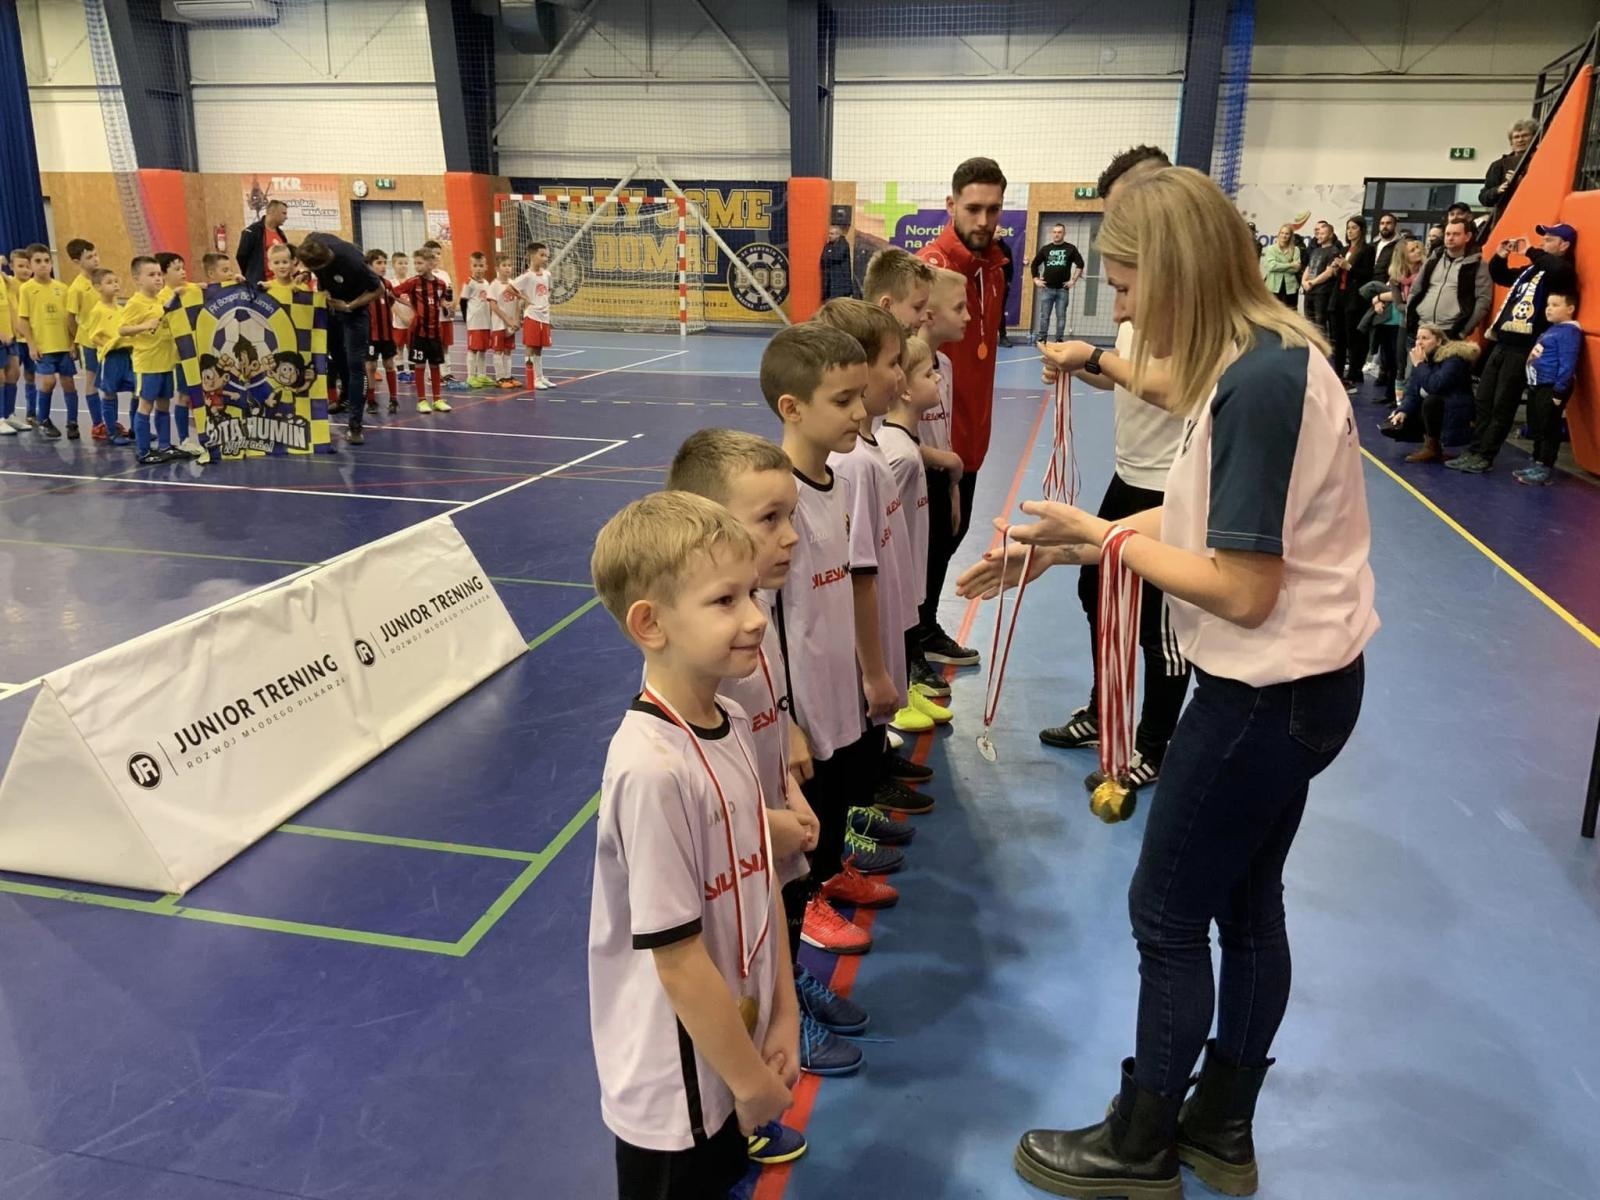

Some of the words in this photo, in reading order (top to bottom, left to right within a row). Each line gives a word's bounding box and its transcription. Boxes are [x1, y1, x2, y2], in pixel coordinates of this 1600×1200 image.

[271, 176, 301, 191] TKR
[904, 240, 922, 249] na
[412, 349, 424, 361] 13
[380, 603, 433, 643] JUNIOR
[429, 575, 484, 614] TRENING
[174, 698, 256, 754] JUNIOR
[253, 653, 338, 708] TRENING
